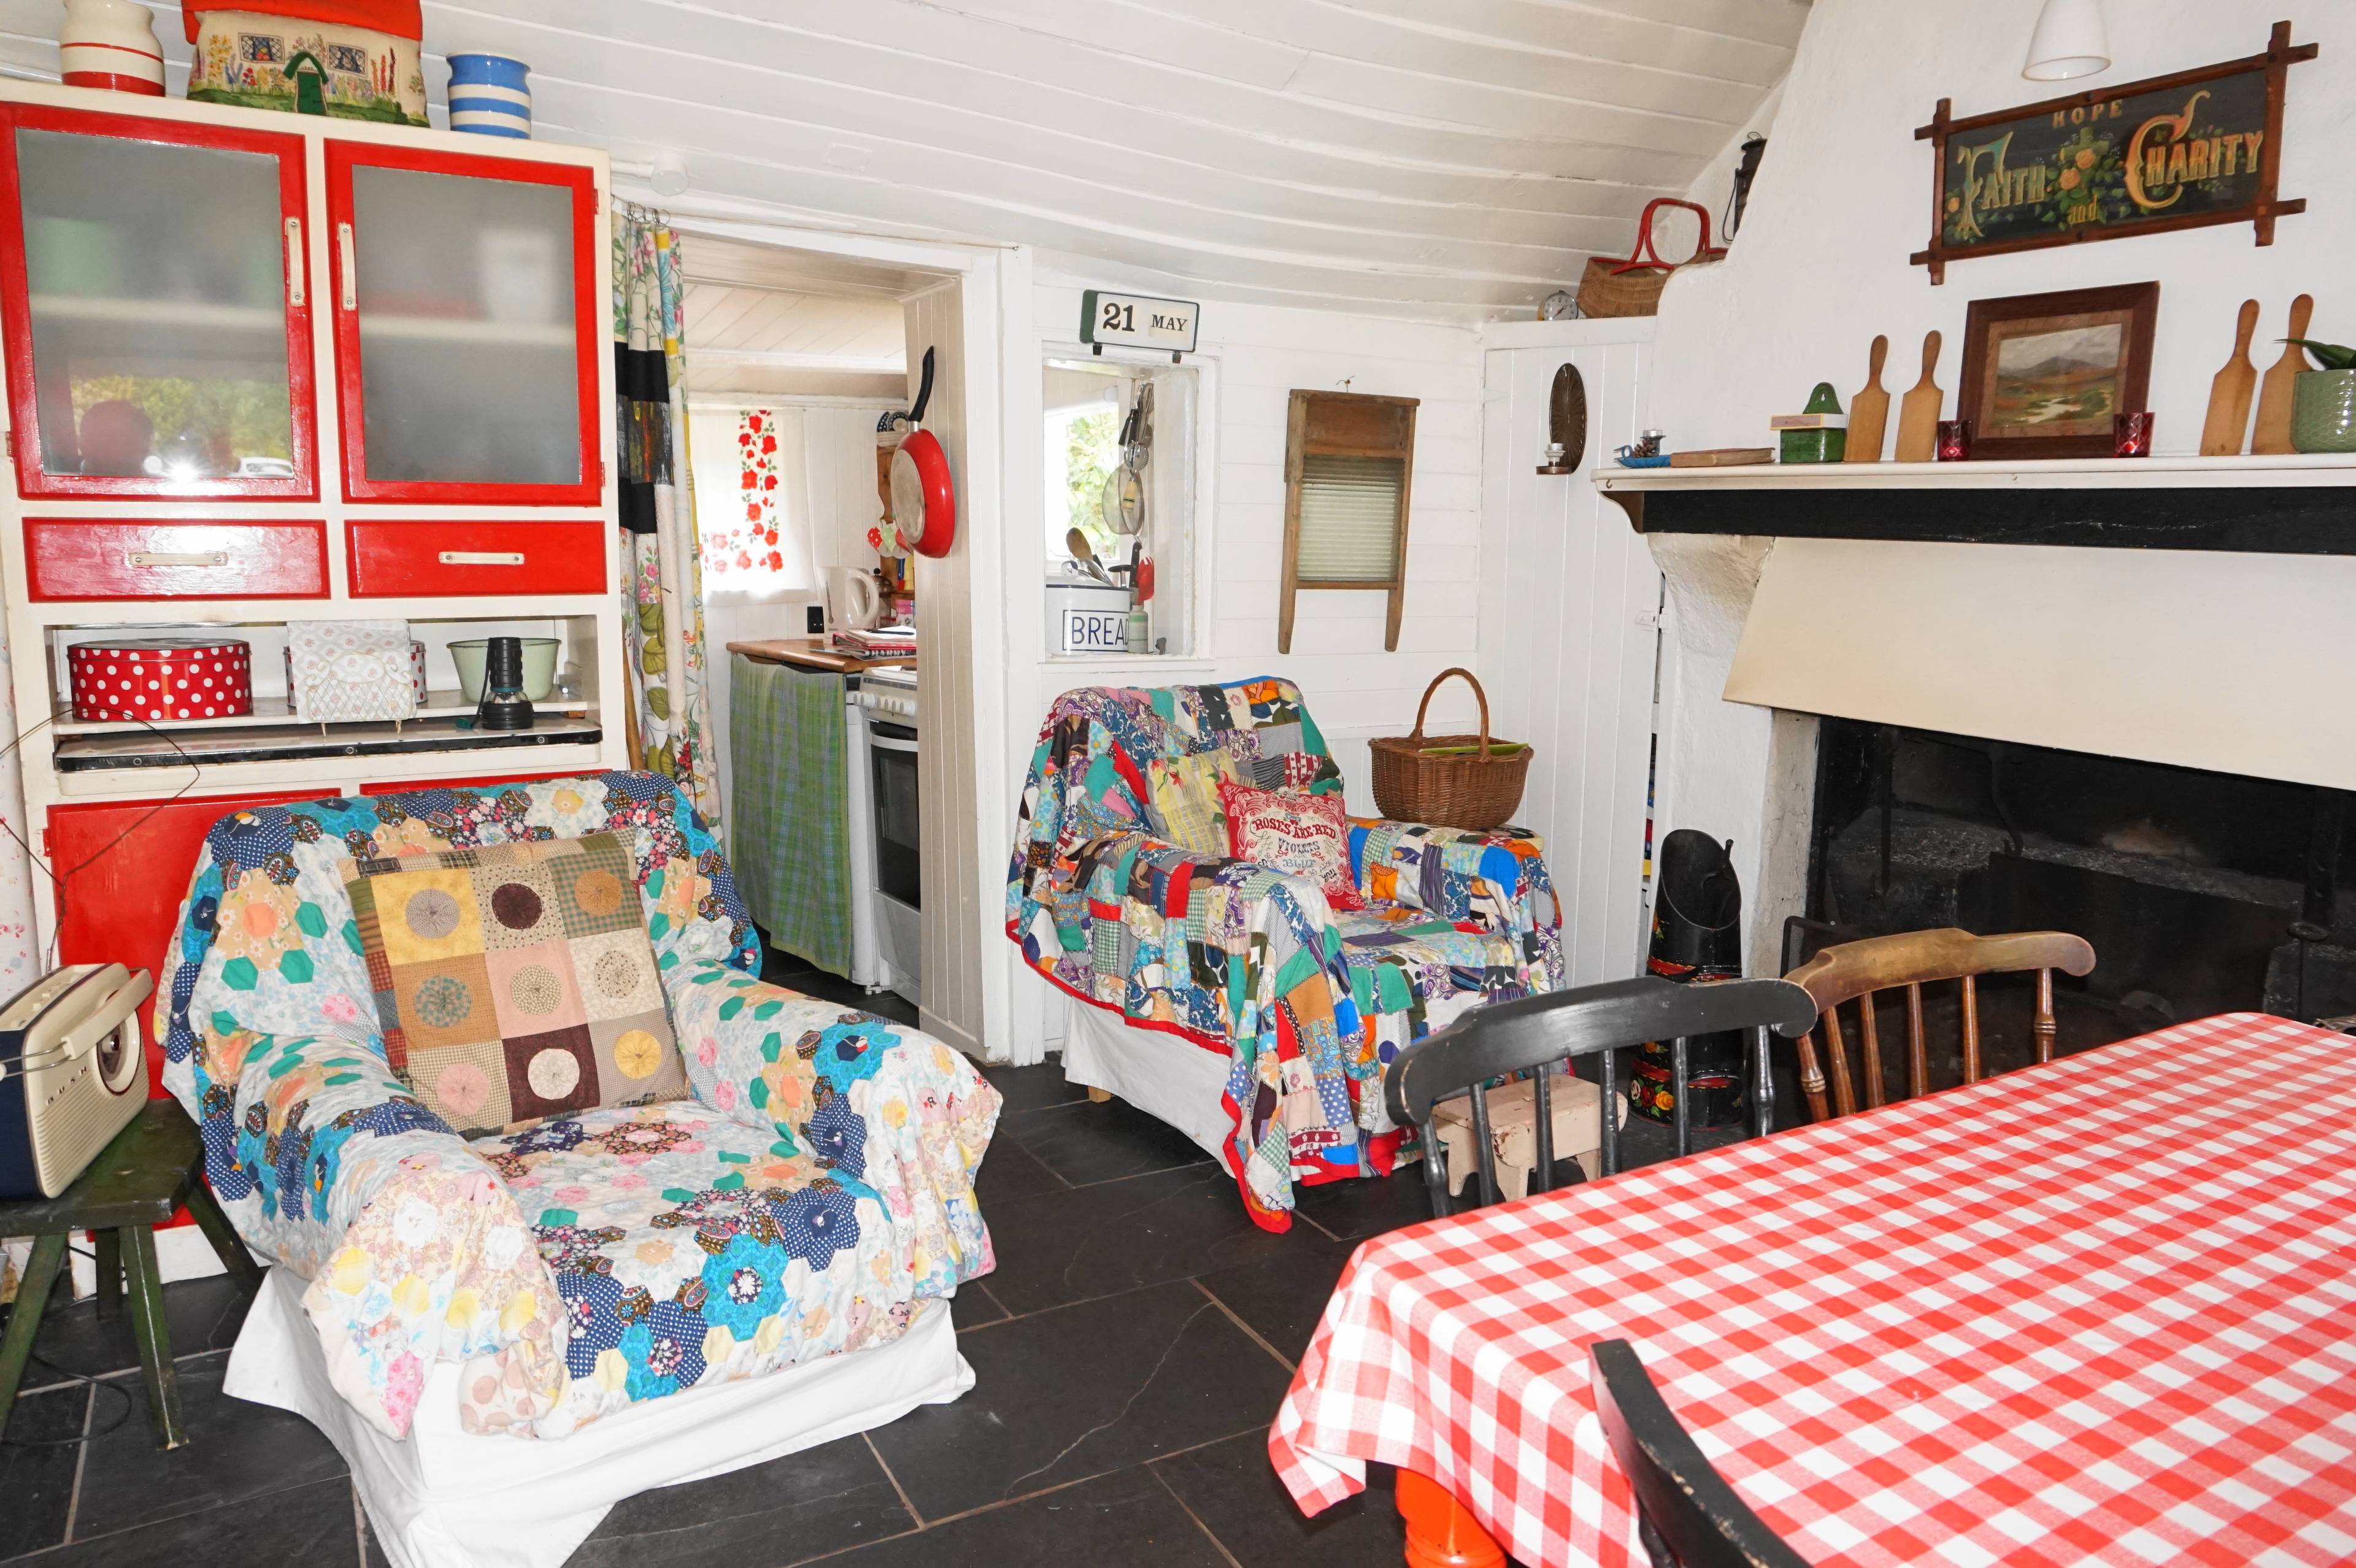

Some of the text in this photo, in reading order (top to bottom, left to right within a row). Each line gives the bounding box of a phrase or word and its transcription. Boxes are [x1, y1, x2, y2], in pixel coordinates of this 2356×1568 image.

[2052, 99, 2123, 129] HOPE
[1957, 90, 2263, 240] FAITH and CHARITY
[1103, 302, 1188, 332] 21 MAY
[1252, 817, 1336, 839] ROSES ARE RED
[1279, 837, 1320, 853] VIOLETS
[1282, 859, 1316, 868] BLUE
[45, 1066, 87, 1106] BUSH
